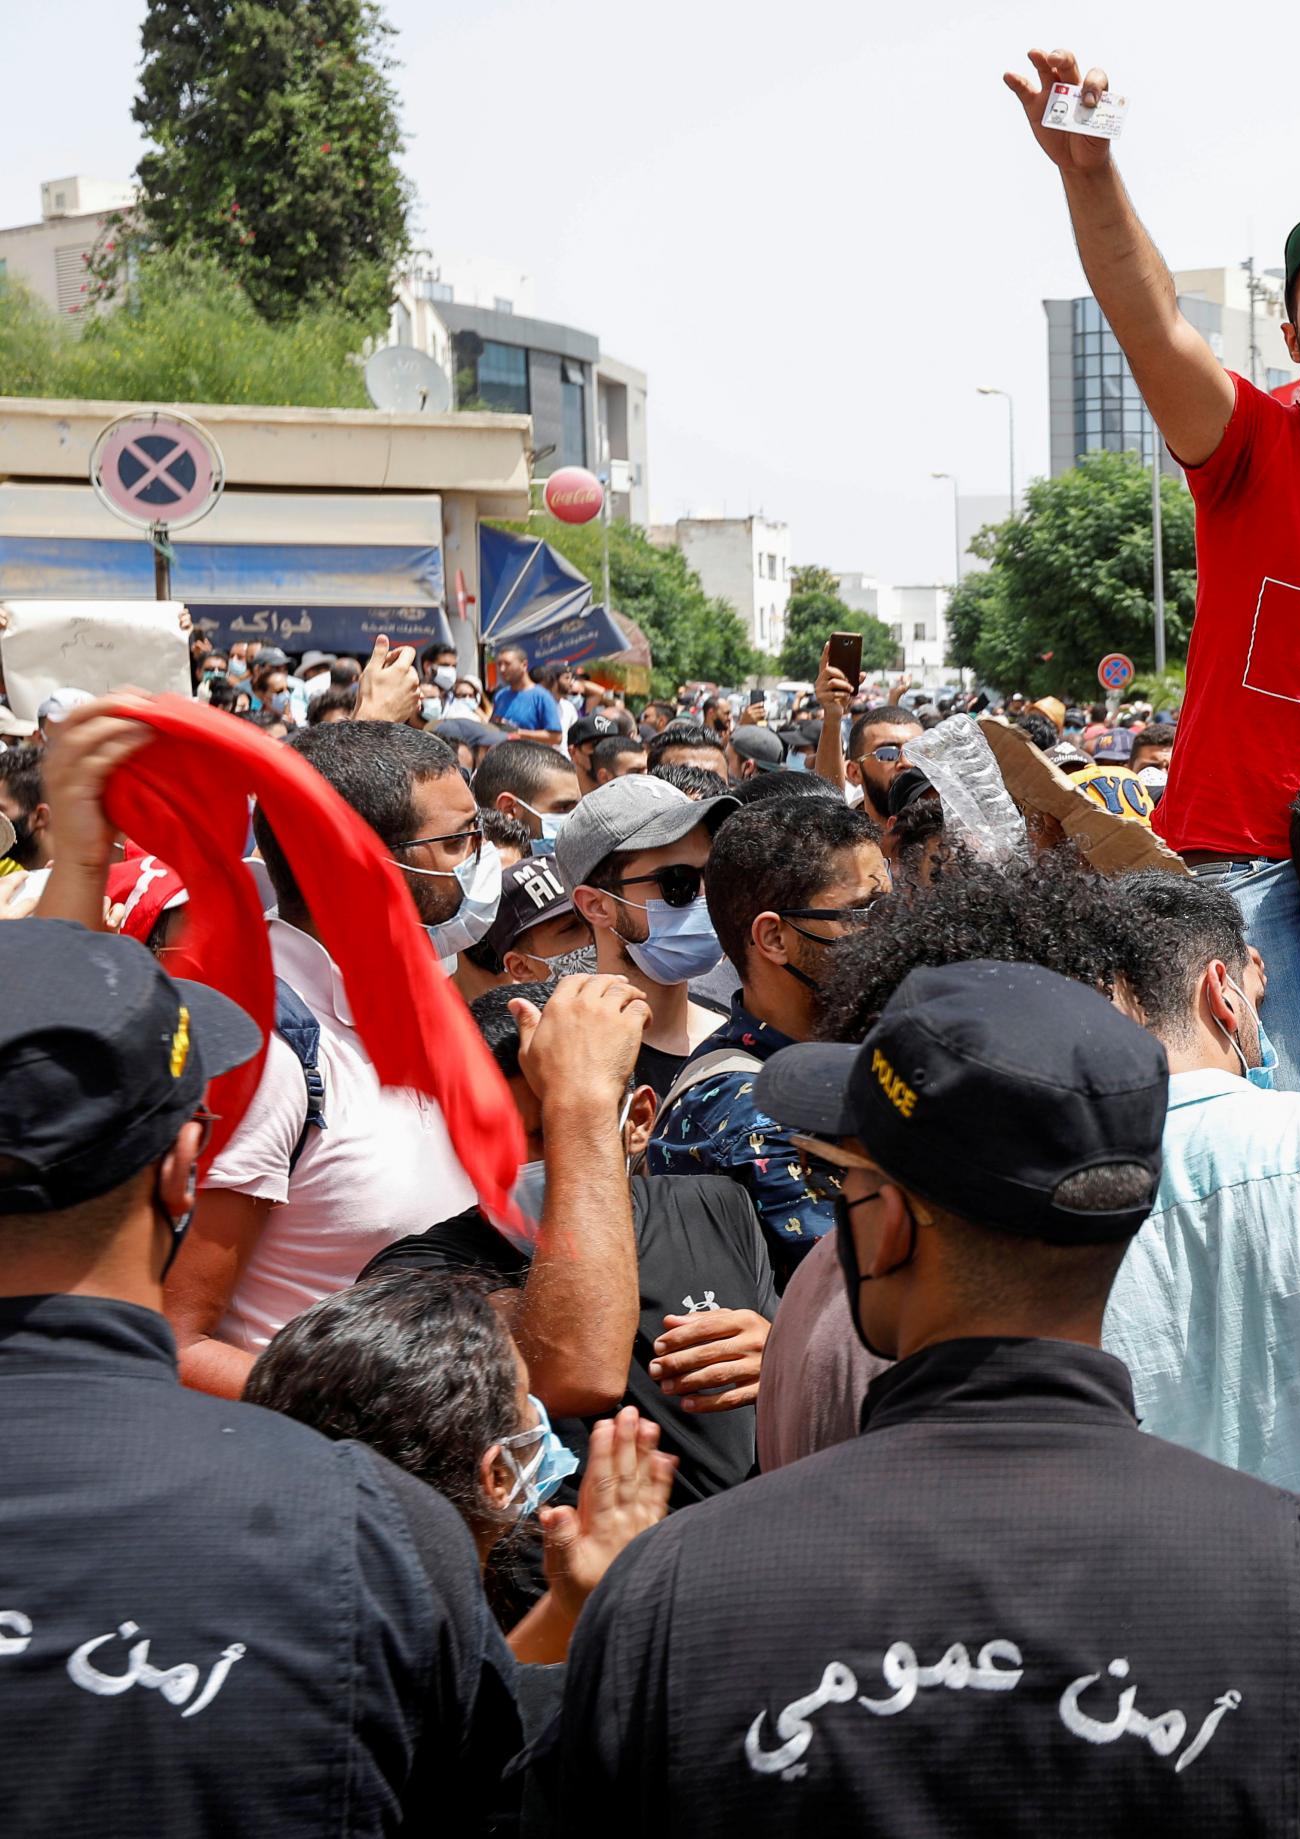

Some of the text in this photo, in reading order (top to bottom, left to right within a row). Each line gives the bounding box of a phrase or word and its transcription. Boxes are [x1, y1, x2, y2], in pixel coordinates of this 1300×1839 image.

[229, 609, 313, 638] فواكه
[1050, 753, 1088, 764] Columbia
[1078, 776, 1148, 817] YC
[512, 857, 549, 885] MY
[871, 1048, 918, 1118] POLICE
[67, 1620, 248, 1718] أمن
[744, 1638, 1243, 1781] أمن عمومي
